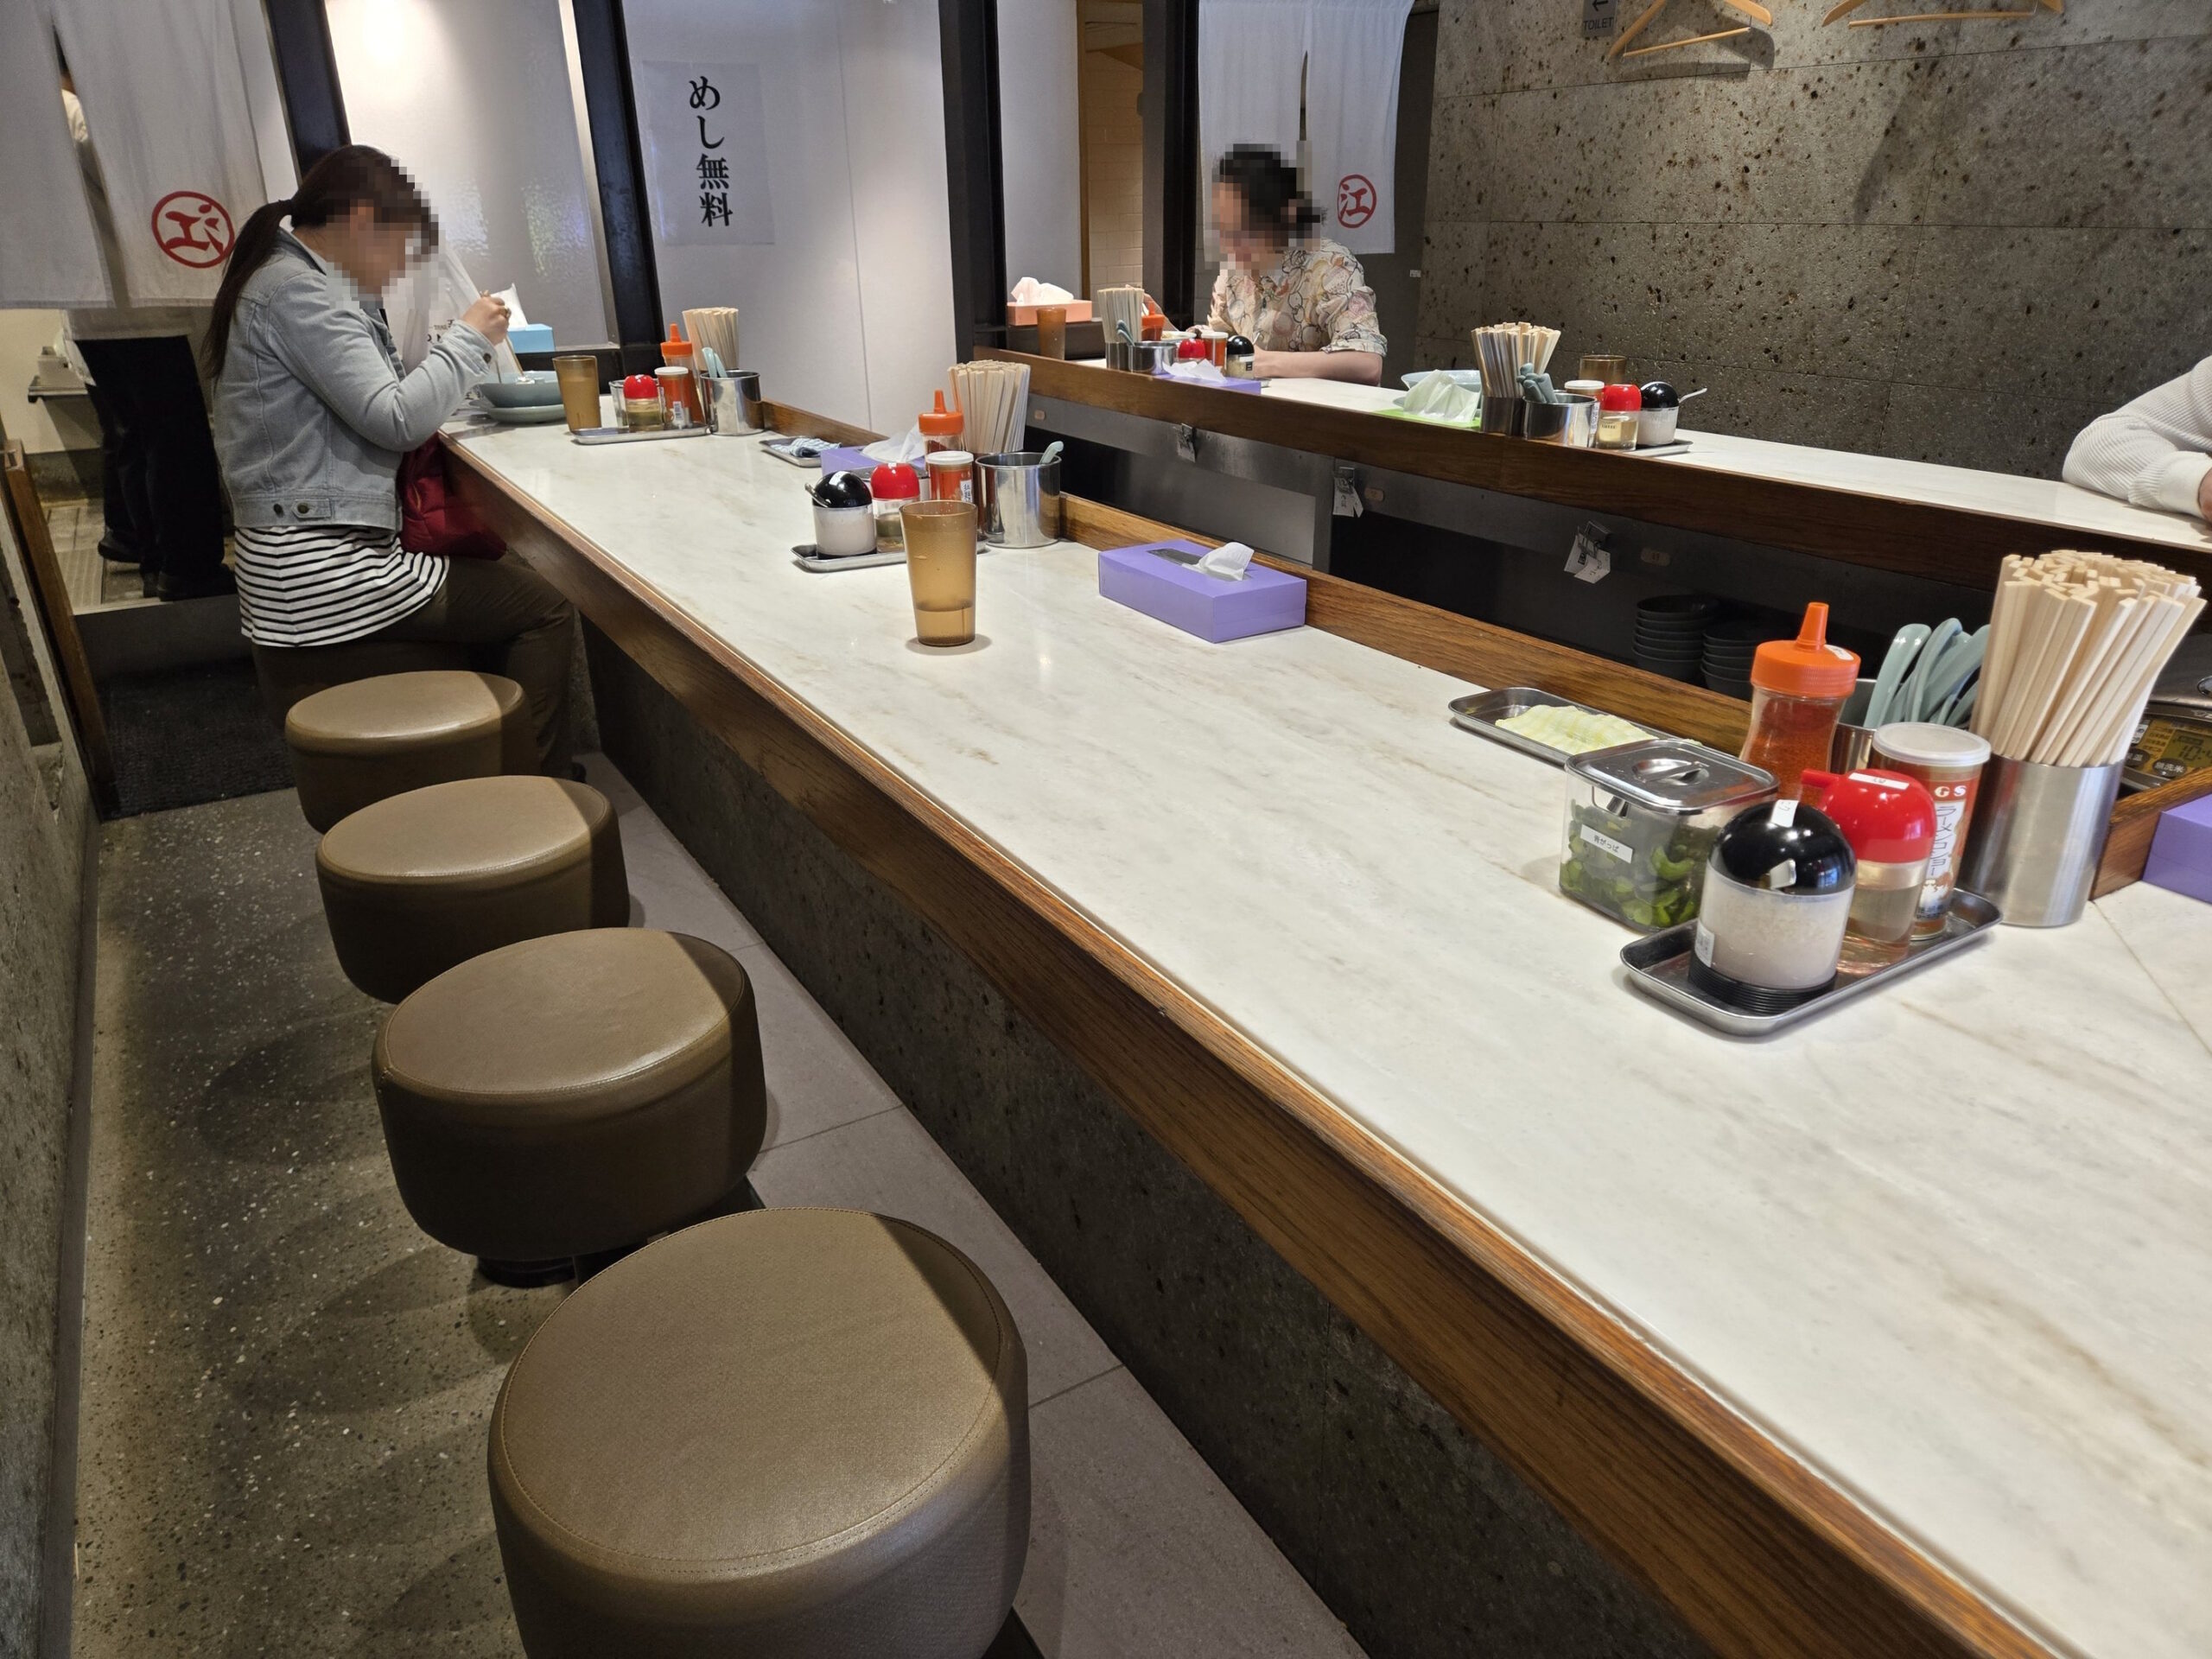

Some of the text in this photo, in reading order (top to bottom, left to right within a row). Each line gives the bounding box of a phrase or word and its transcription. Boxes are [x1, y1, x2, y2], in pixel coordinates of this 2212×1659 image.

[1582, 16, 1614, 30] TOILET
[689, 75, 734, 227] めし無料
[1338, 181, 1371, 222] 江
